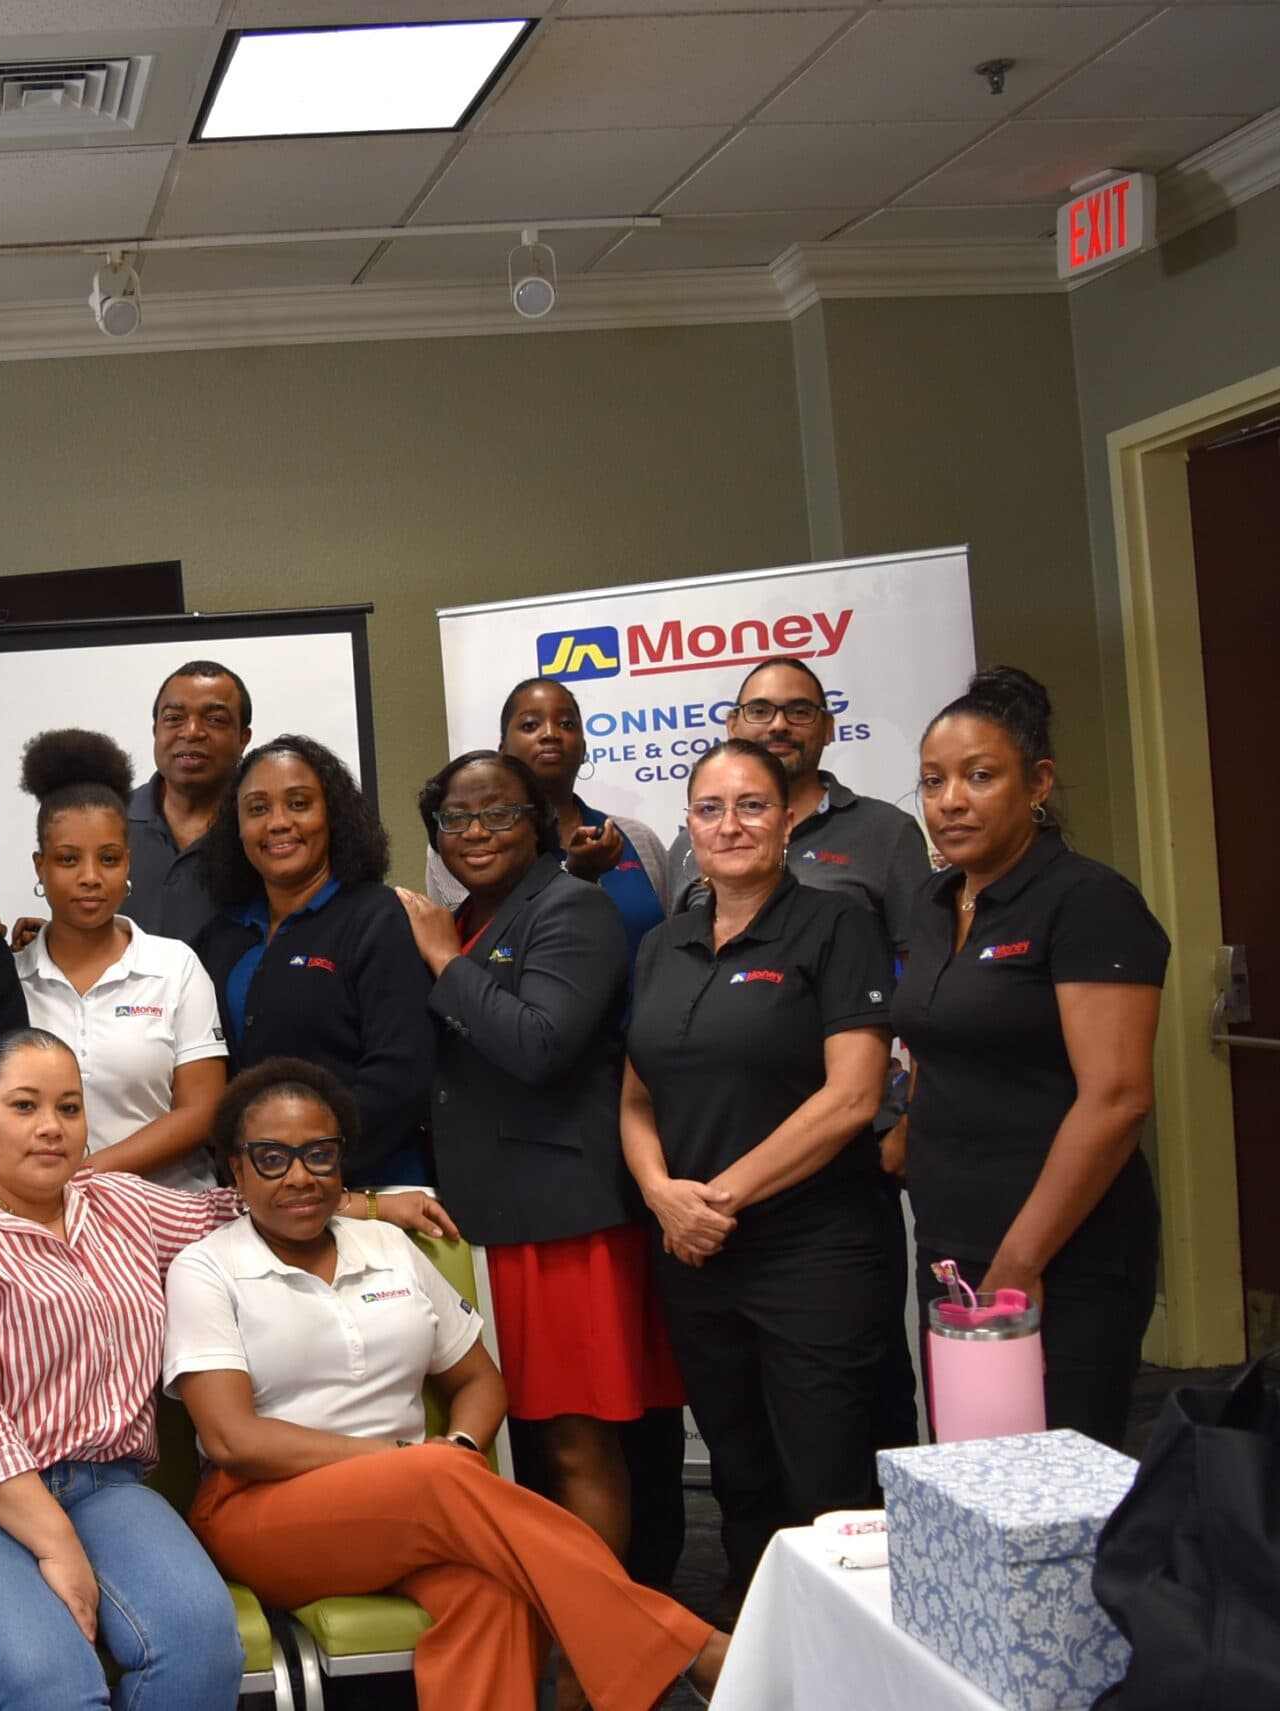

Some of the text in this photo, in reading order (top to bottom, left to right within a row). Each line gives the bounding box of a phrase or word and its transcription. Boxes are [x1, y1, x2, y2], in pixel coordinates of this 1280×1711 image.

[1070, 181, 1130, 268] EXIT
[627, 609, 853, 674] Money
[585, 690, 849, 737] ONNECG
[584, 744, 637, 764] PLE
[645, 743, 663, 759] &
[131, 1006, 163, 1017] Money
